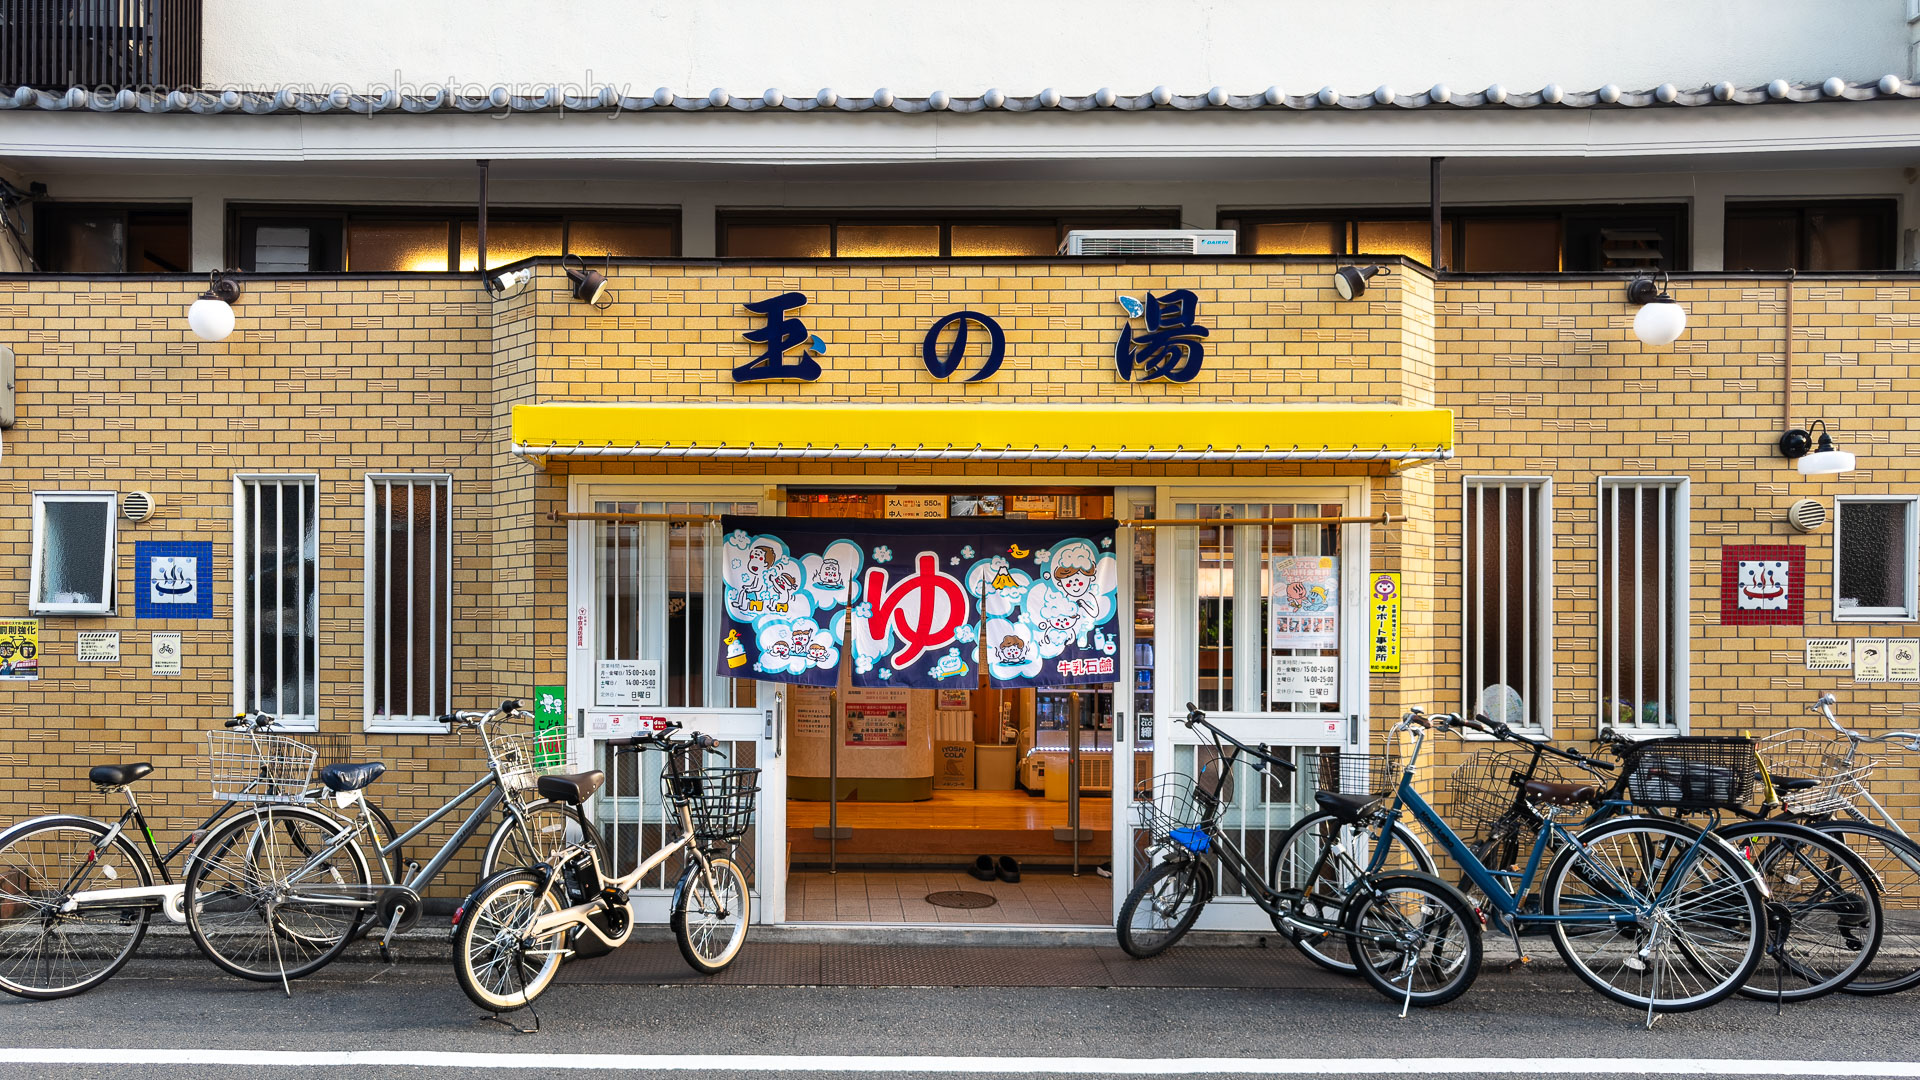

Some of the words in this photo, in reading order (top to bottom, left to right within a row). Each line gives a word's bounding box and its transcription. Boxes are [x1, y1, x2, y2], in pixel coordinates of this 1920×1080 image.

[731, 288, 1210, 385] 玉の湯
[865, 551, 970, 670] ゆ
[1376, 604, 1388, 662] サポート事業所
[1141, 727, 1152, 738] 締
